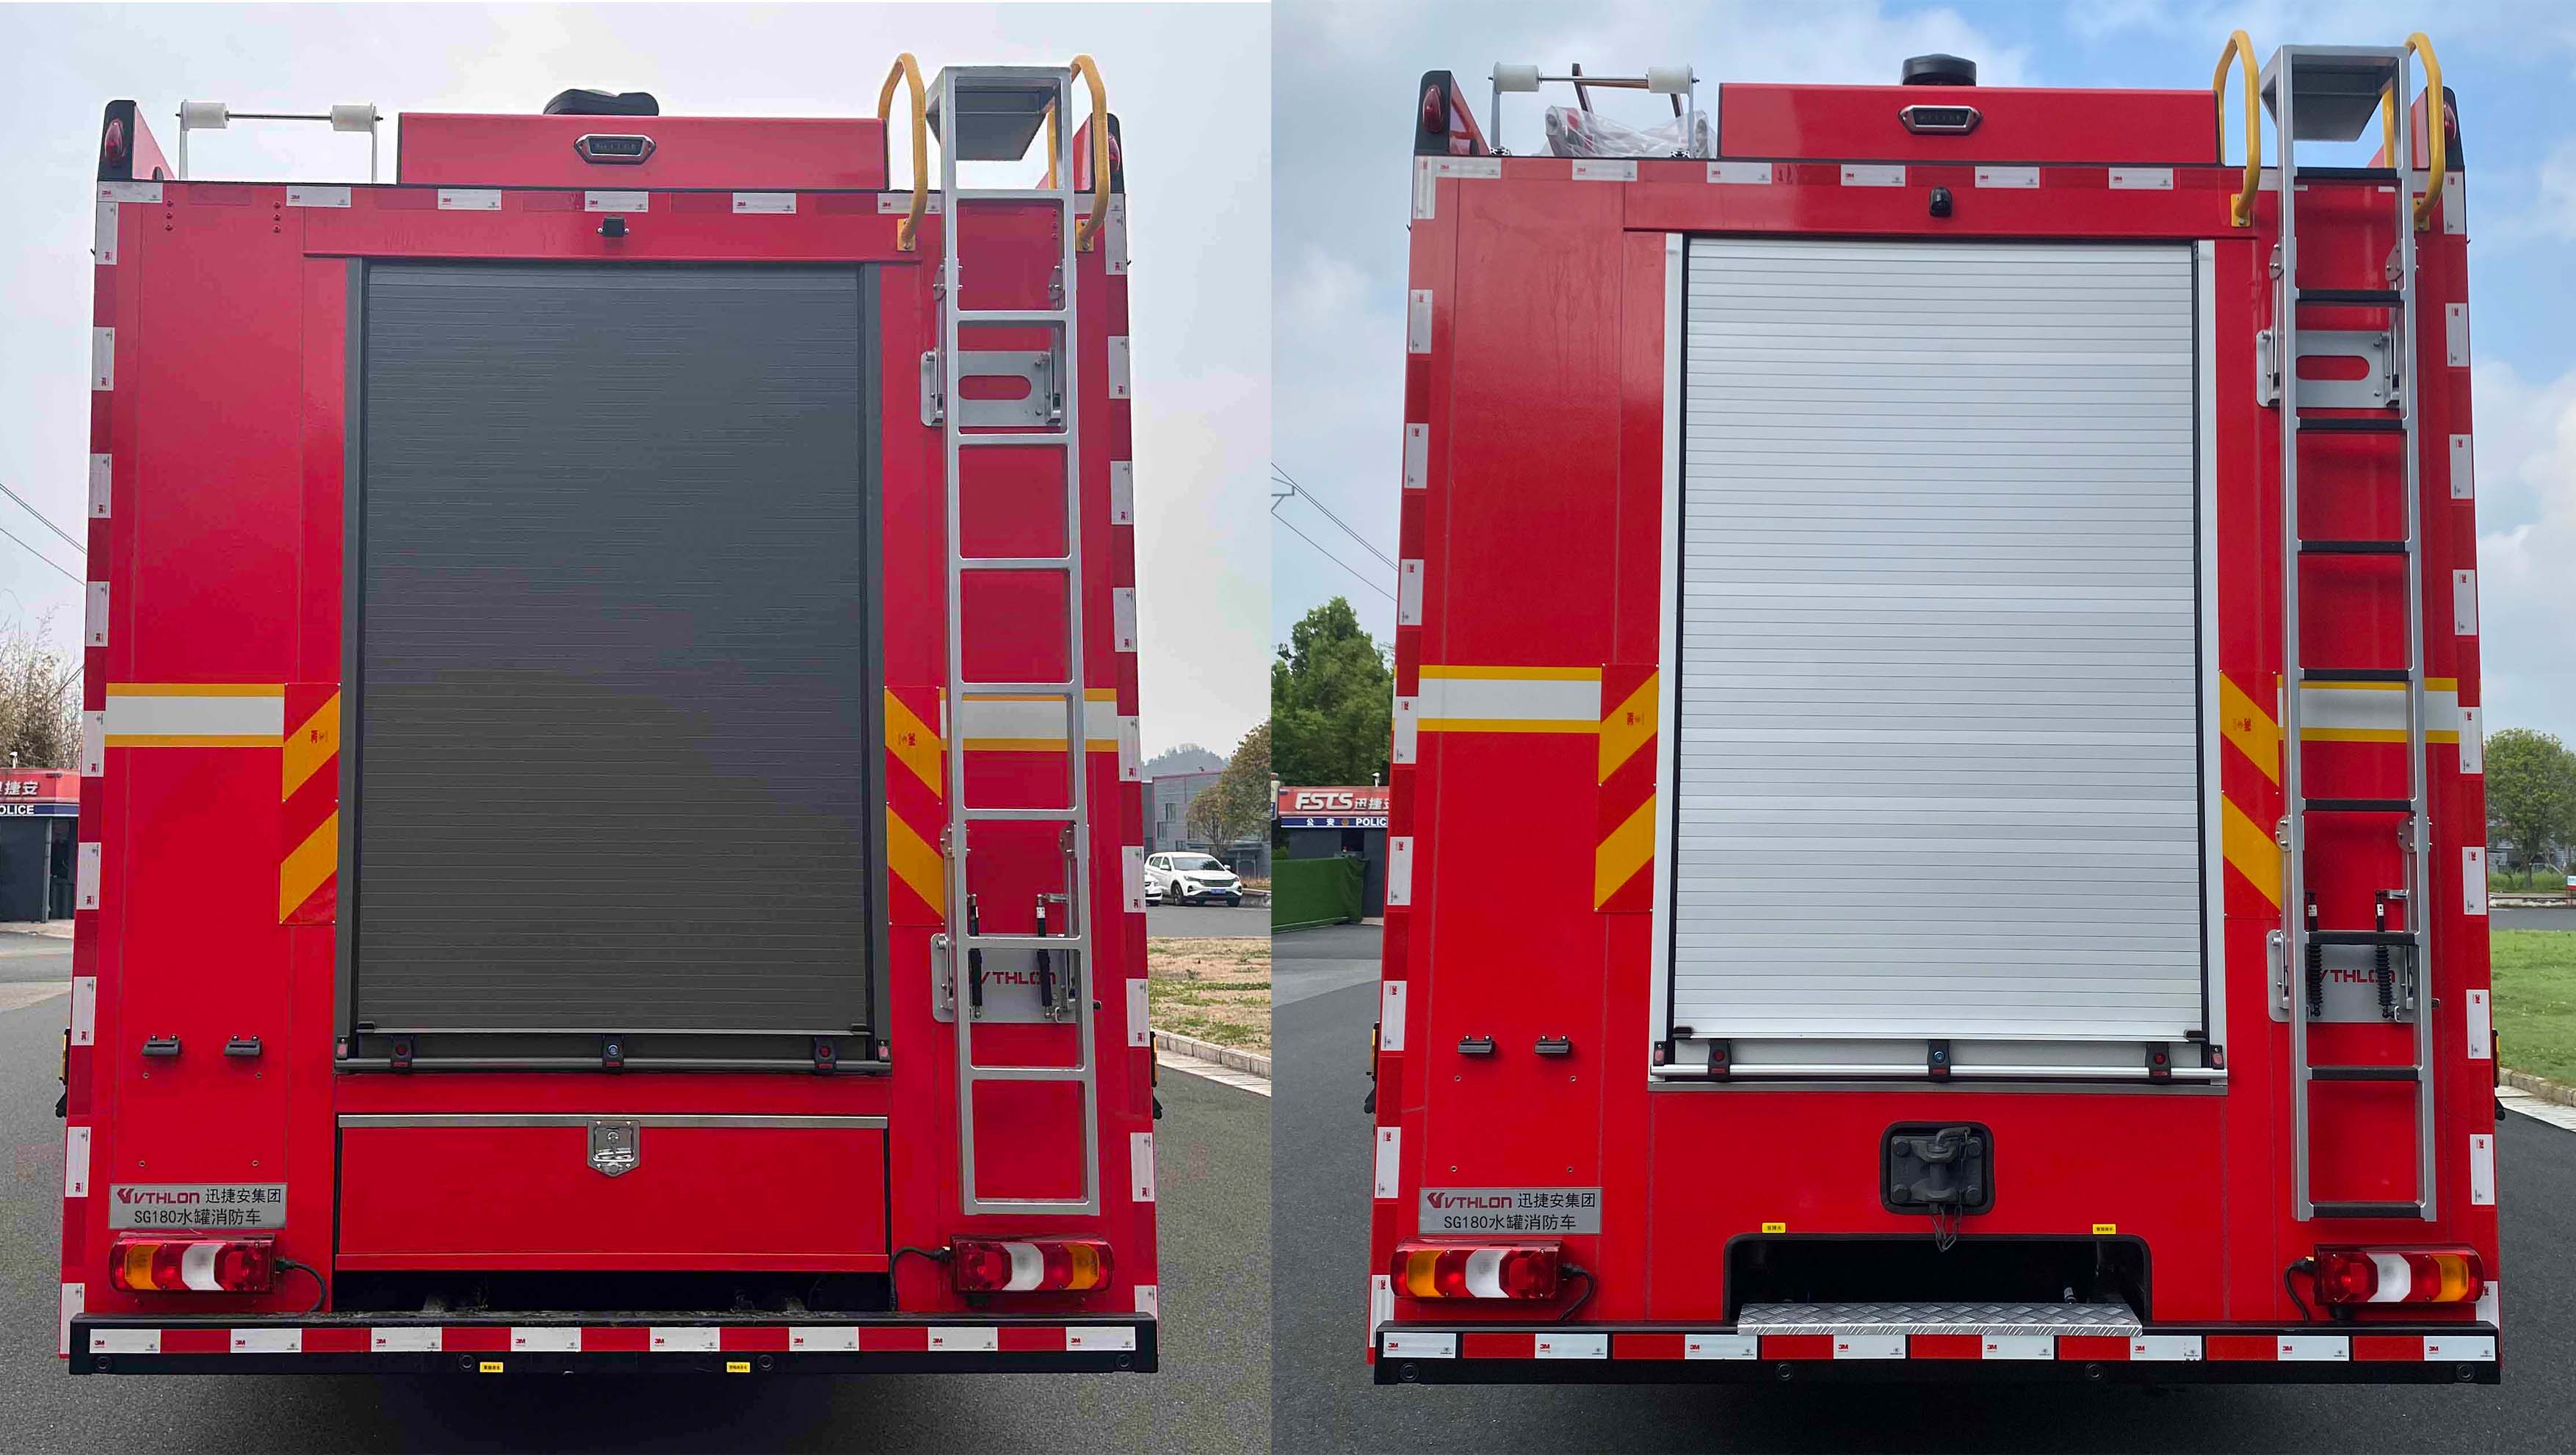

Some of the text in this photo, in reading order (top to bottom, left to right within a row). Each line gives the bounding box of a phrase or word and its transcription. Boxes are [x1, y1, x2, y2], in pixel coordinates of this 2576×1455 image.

[0, 781, 38, 795] 捷安
[1295, 793, 1353, 810] FSTS
[134, 1188, 281, 1204] VTHLON 迅捷安集团
[1445, 1193, 1596, 1208] VTHLON 迅捷安集团
[134, 1208, 261, 1225] SG180水罐消防车
[1444, 1214, 1576, 1231] SG180水罐消防车
